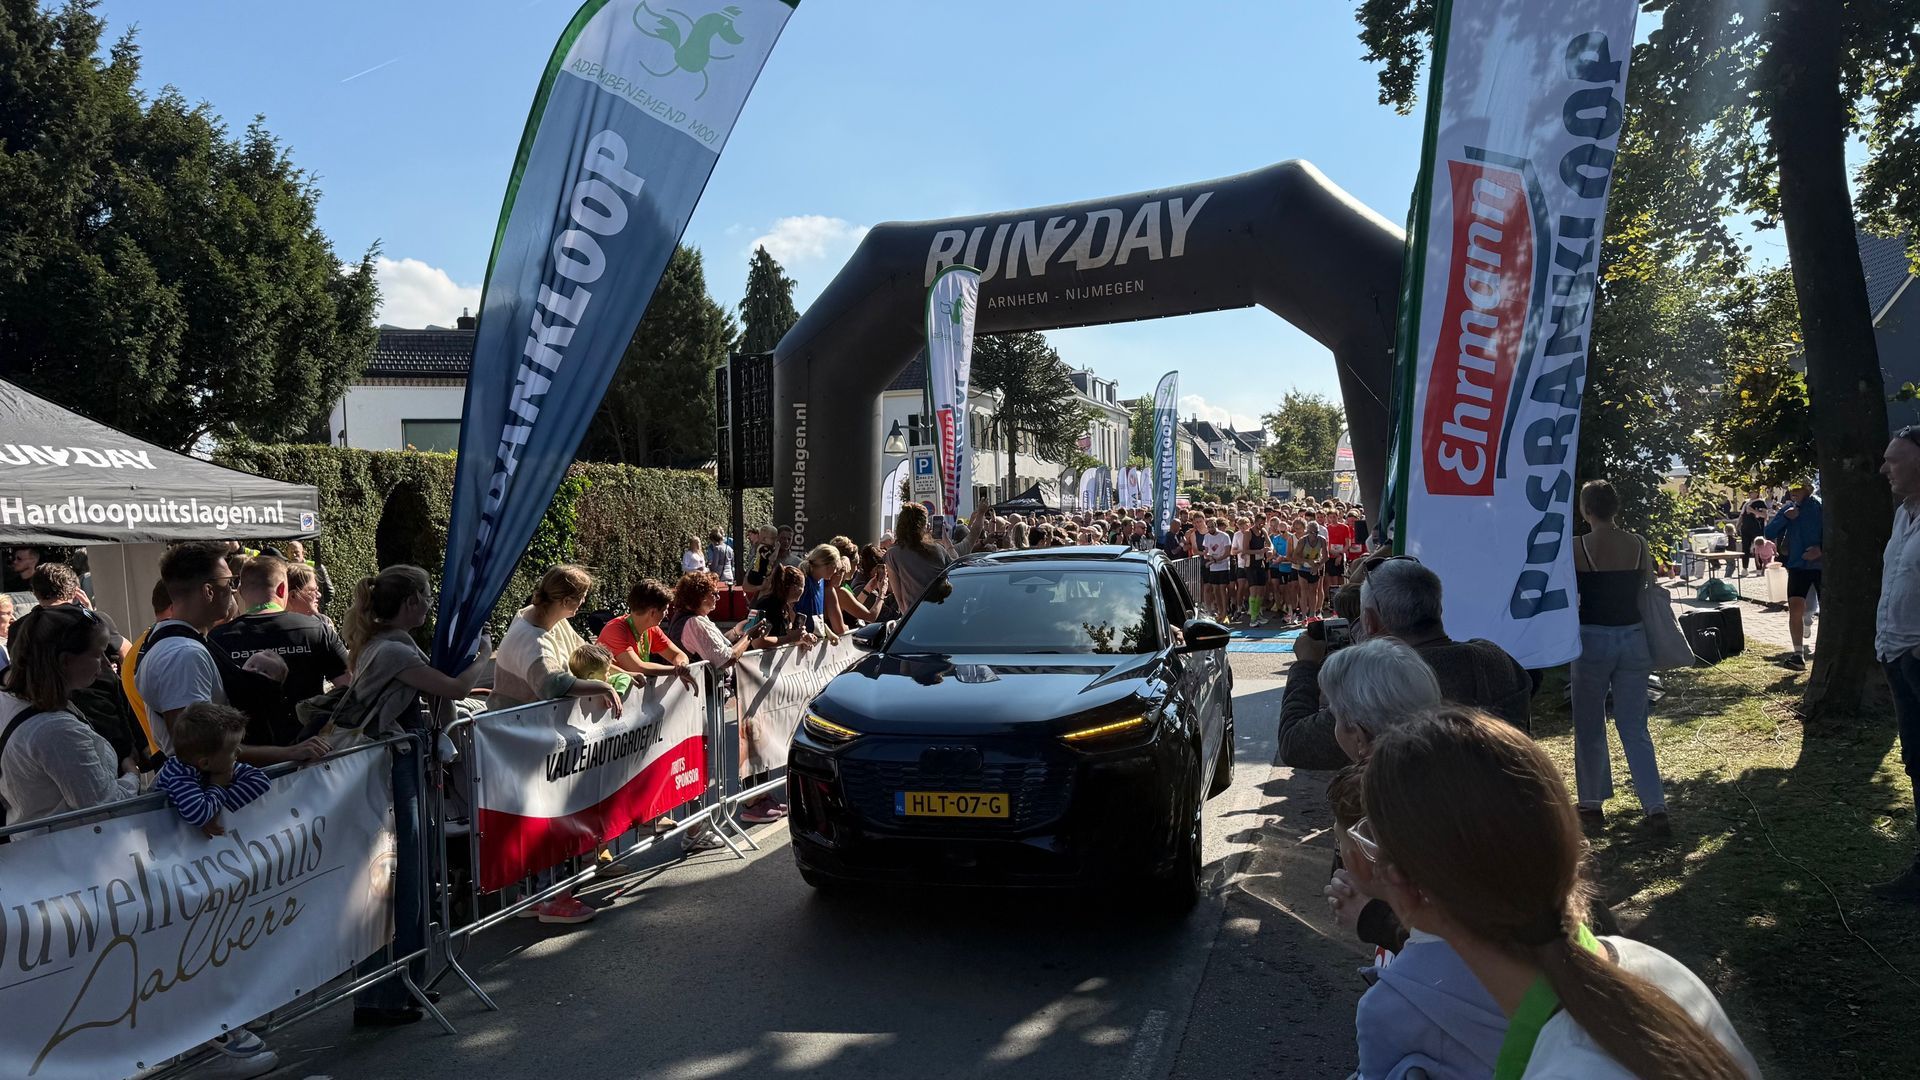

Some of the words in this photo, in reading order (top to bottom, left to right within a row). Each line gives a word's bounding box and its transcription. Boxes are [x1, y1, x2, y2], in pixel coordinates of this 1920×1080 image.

[571, 58, 686, 123] ADEMBENEMEND
[688, 119, 719, 144] MOOI
[924, 191, 1214, 288] RUN2DAY
[988, 291, 1048, 309] ARNHEM
[1065, 279, 1145, 301] NIJMEGEN
[470, 129, 645, 575] BANKLOOP
[1437, 178, 1507, 486] Ehrmann
[0, 443, 157, 470] UN2DAY
[791, 403, 809, 553] loopuitslagen.nl
[918, 458, 929, 474] P
[0, 496, 284, 530] Hardloopuitslagen.nl
[546, 718, 663, 783] VALLEIAUTOGROEP.NL
[675, 767, 699, 790] SPONSOR
[912, 794, 1001, 815] HLT-07-G
